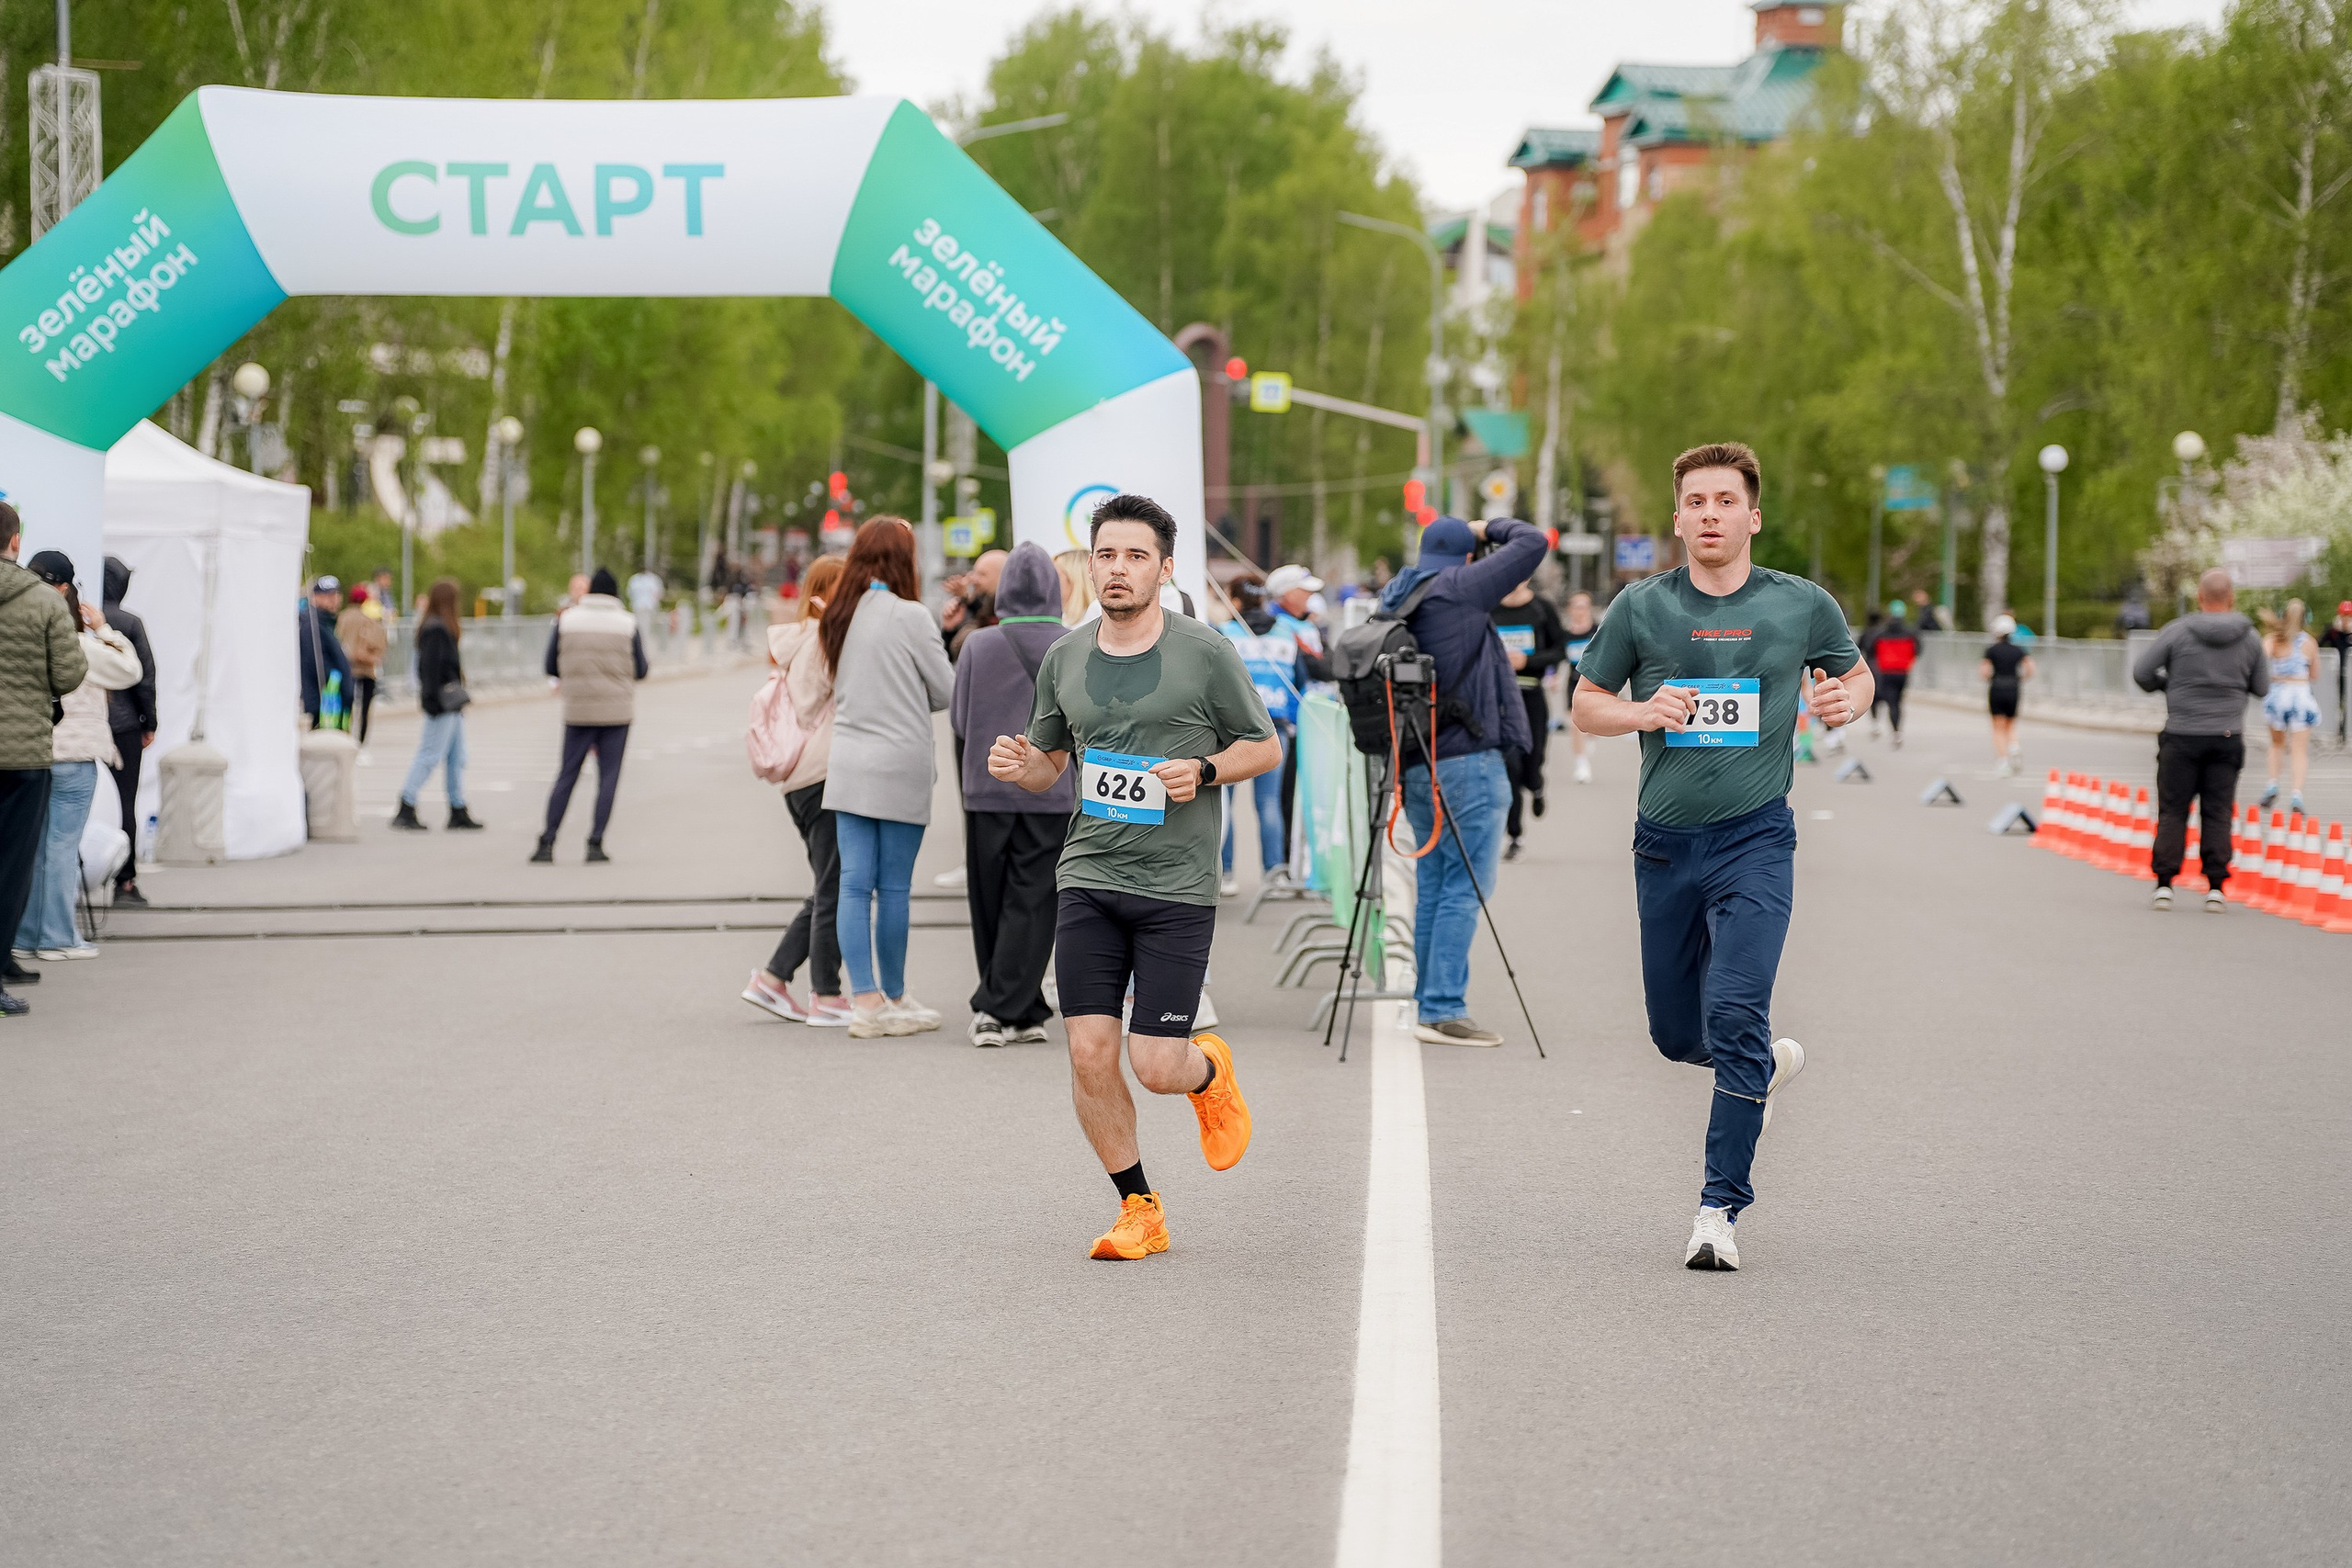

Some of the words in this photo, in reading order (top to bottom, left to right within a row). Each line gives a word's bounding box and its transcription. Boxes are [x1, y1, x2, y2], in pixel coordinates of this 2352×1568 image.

[371, 160, 726, 237] СТАРТ
[18, 207, 172, 354] зелёный
[44, 242, 199, 383] марафон
[888, 243, 1036, 382] марафон
[913, 218, 1068, 355] зелёный
[1691, 629, 1722, 637] NIKE
[1723, 628, 1752, 637] PRO
[1097, 772, 1146, 802] 626
